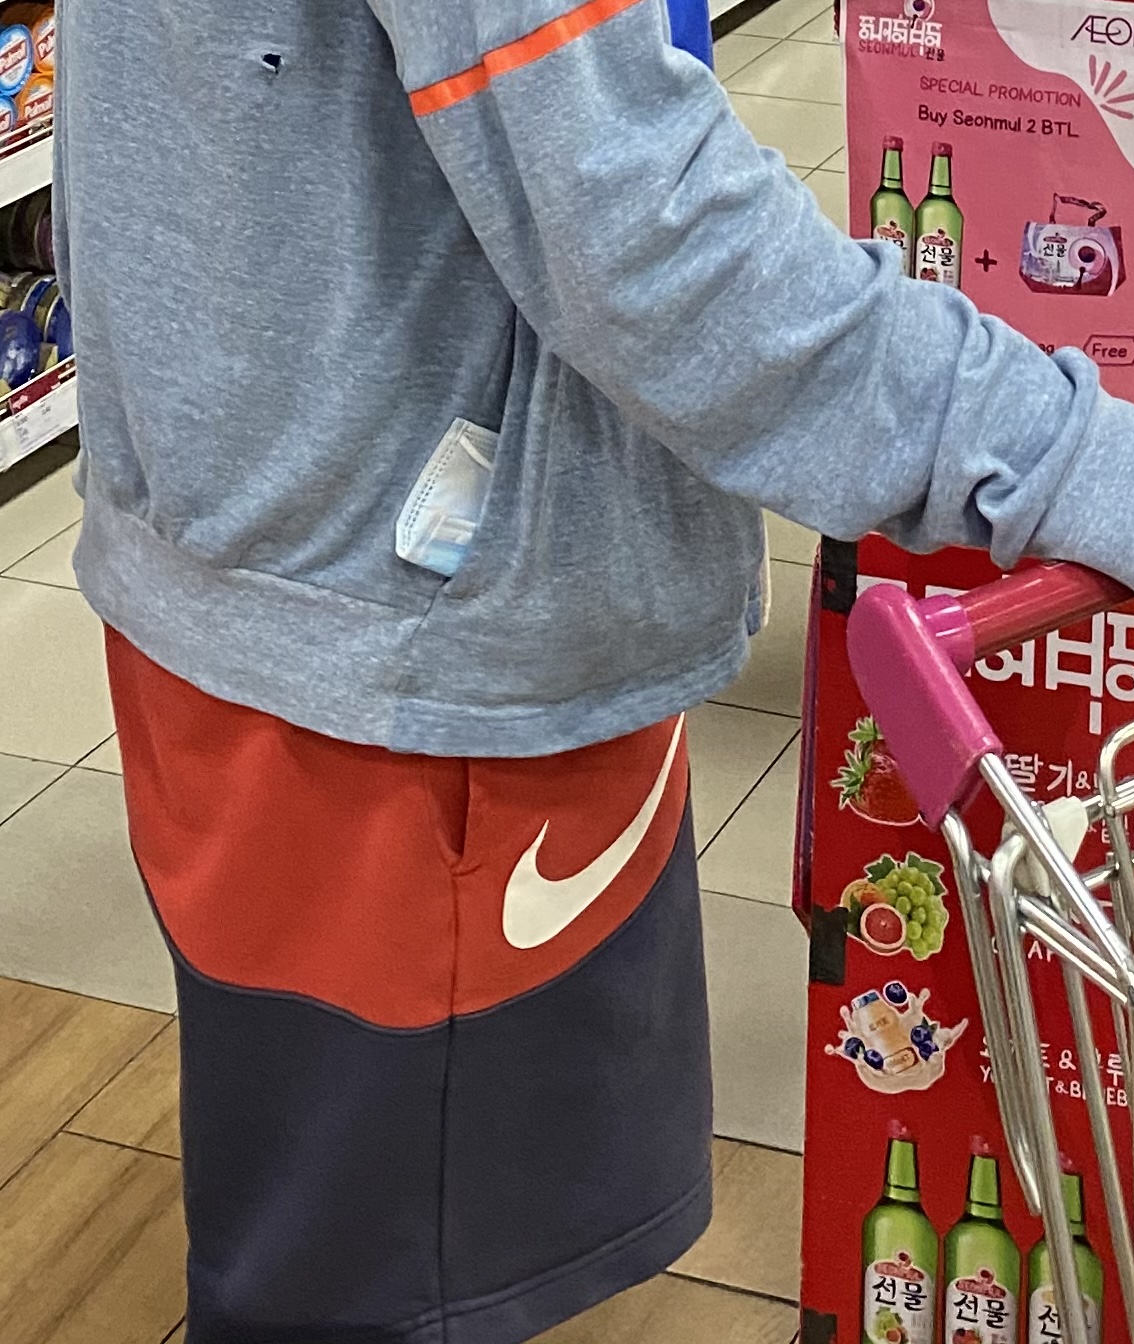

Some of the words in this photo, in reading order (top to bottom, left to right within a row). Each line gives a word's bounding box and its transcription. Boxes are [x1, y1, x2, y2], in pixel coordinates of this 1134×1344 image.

[919, 75, 983, 97] SPECIAL
[988, 84, 1081, 108] PROMOTION
[918, 104, 948, 127] Buy
[953, 110, 1022, 133] Seonmul
[1026, 119, 1036, 133] 2
[1041, 120, 1080, 138] BTL
[920, 244, 956, 266] 선물
[1091, 342, 1128, 359] Free
[872, 1275, 927, 1312] 선물
[952, 1292, 1010, 1329] 선물
